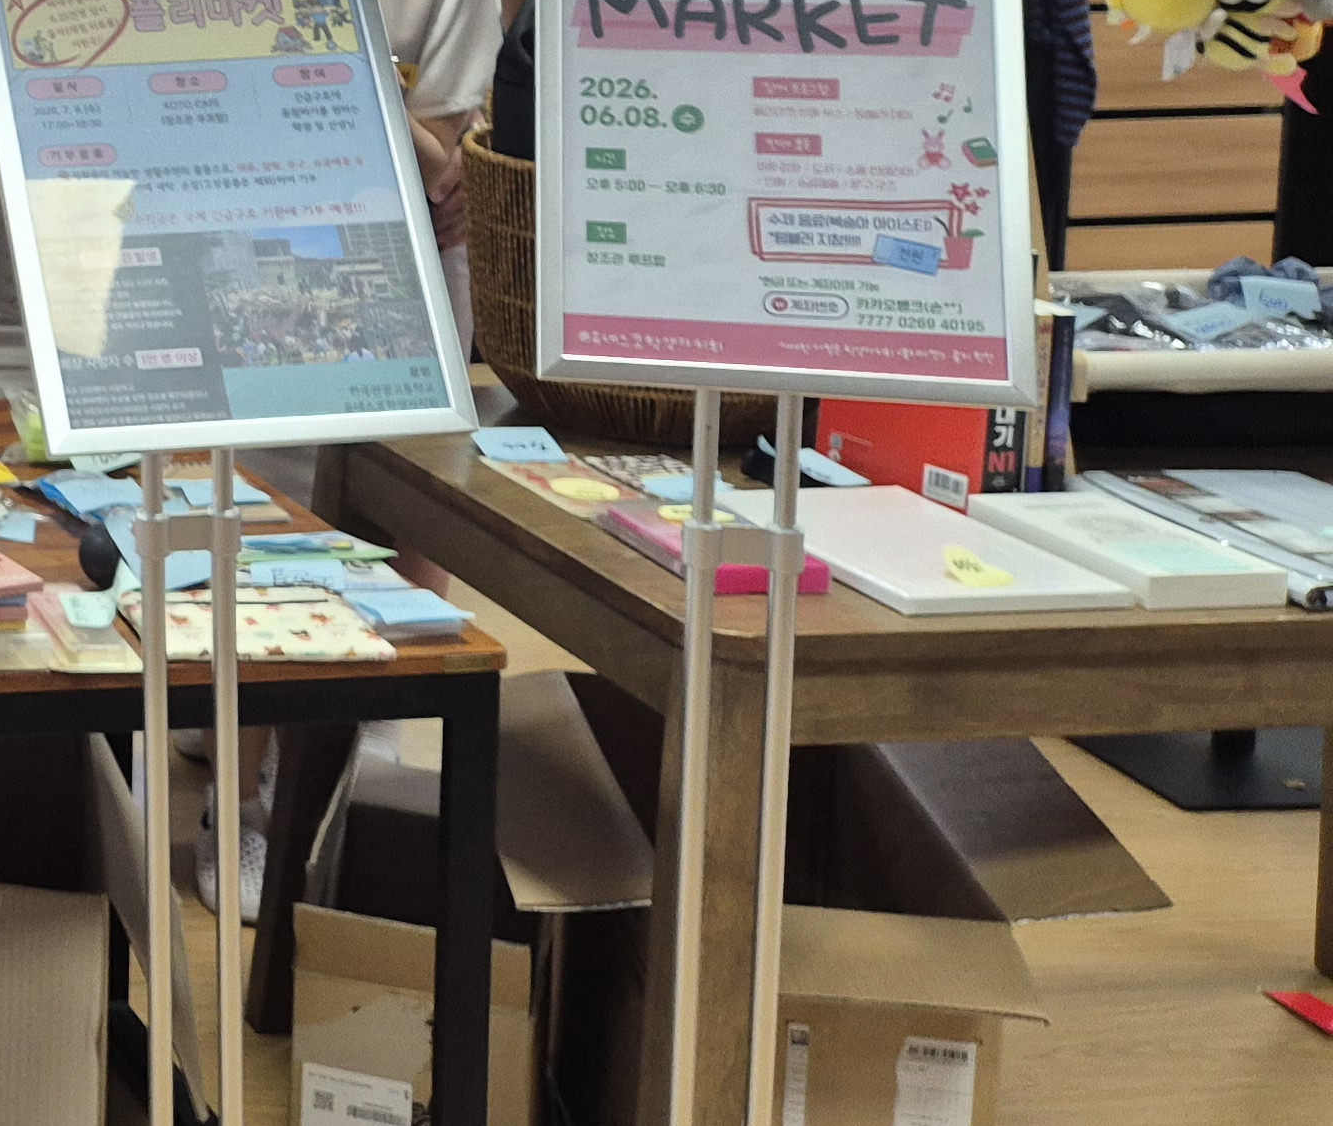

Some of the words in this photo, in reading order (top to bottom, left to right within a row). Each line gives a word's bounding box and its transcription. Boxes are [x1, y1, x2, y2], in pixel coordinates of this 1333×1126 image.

[579, 76, 658, 100] 2026.
[580, 104, 668, 128] 06.08.
[857, 314, 895, 326] 7777
